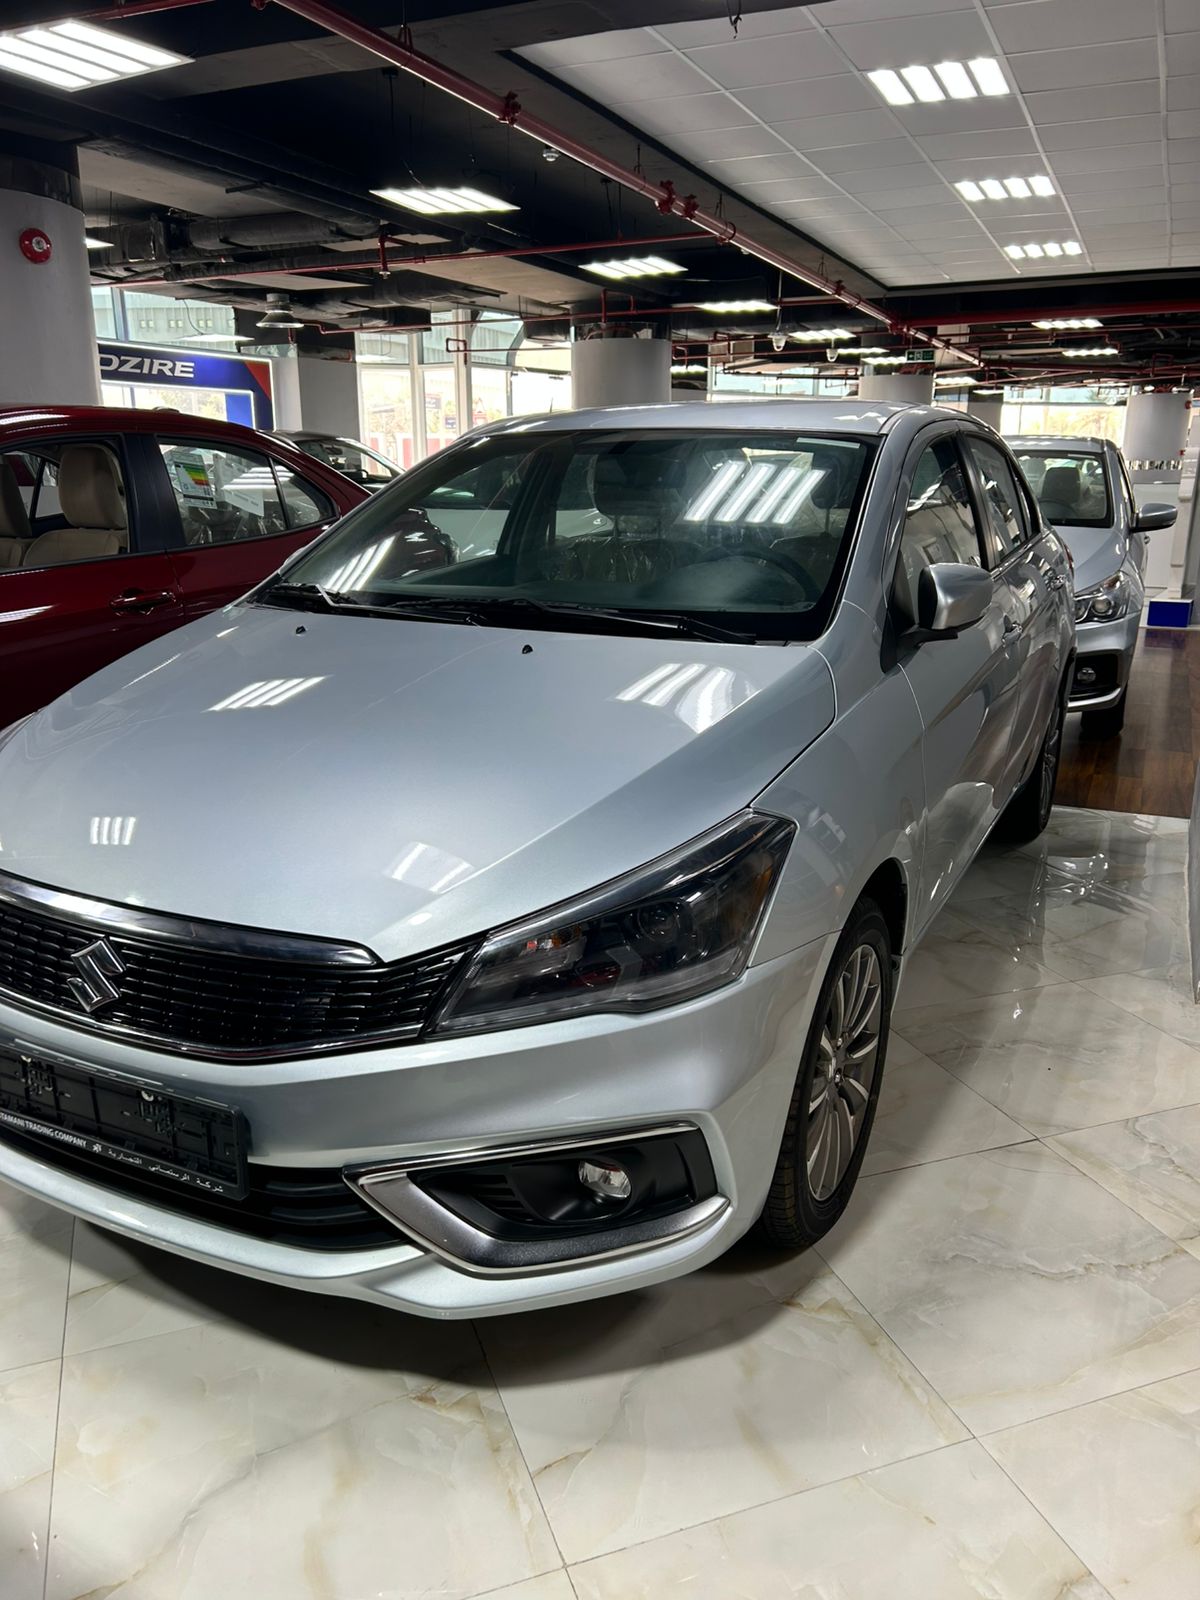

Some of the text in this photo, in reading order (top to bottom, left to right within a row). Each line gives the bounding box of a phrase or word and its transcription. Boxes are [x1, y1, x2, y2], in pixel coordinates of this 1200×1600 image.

[99, 353, 195, 378] DZIRE
[25, 1121, 54, 1137] TRADING
[55, 1130, 87, 1148] COMPANY
